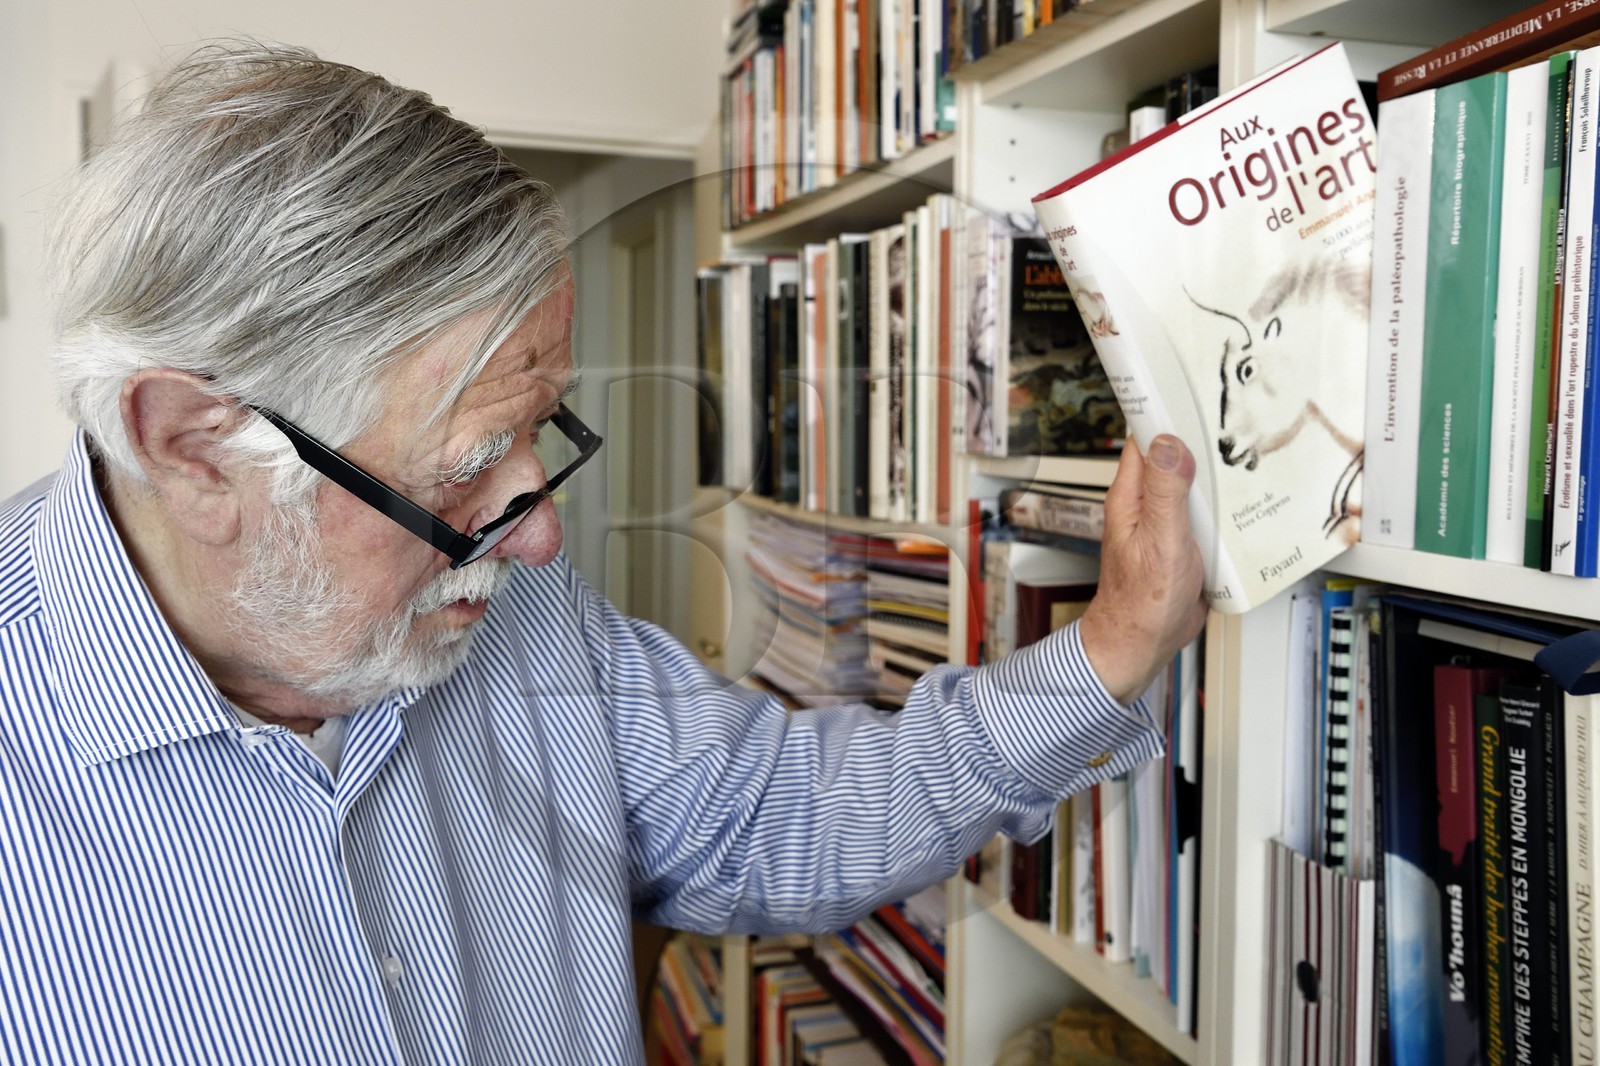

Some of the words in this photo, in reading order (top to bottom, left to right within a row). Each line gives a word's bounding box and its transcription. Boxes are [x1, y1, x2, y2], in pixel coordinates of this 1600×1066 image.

[1429, 58, 1442, 70] LA
[1445, 51, 1457, 66] ET
[1580, 68, 1593, 118] Soleilhavoup
[1220, 114, 1265, 152] Aux
[1454, 100, 1467, 180] biographique
[1579, 120, 1590, 152] François
[1168, 97, 1366, 226] Origines
[1266, 206, 1294, 232] de
[1286, 138, 1377, 215] l'art
[1299, 200, 1353, 240] Emmanuel
[1451, 183, 1462, 246] Répertoire
[1556, 208, 1564, 233] Nebra
[1392, 176, 1408, 304] paléopathologie
[1556, 234, 1563, 244] de
[1555, 246, 1565, 274] Disque
[1572, 235, 1585, 292] préhistorique
[1554, 274, 1562, 284] Le
[1389, 310, 1400, 324] la
[1569, 295, 1581, 326] Sahara
[1389, 329, 1400, 347] de
[1569, 328, 1579, 339] du
[1568, 342, 1580, 377] rupestre
[1385, 352, 1399, 442] L'invention
[1565, 380, 1576, 397] l'art
[1565, 400, 1575, 420] dans
[1442, 404, 1452, 454] sciences
[1544, 423, 1554, 463] Crowhurst
[1563, 422, 1574, 460] sexualité
[1440, 457, 1450, 478] des
[1543, 465, 1552, 494] Howard
[1563, 462, 1572, 470] et
[1232, 500, 1262, 523] Préface
[1264, 490, 1275, 502] de
[1438, 480, 1449, 537] Académie
[1559, 472, 1572, 509] Érotisme
[1236, 518, 1256, 532] Yves
[1256, 494, 1292, 520] Coppens
[1259, 546, 1304, 582] Fayard
[1482, 724, 1502, 797] Grand
[1577, 714, 1591, 806] AUJOURD'HUI
[1509, 747, 1527, 842] MONGOLIE
[1484, 800, 1502, 858] traité
[1576, 810, 1586, 820] À
[1512, 846, 1528, 874] EN
[1577, 822, 1588, 870] D'HIER
[1484, 862, 1504, 894] des
[1485, 896, 1505, 964] herbes
[1513, 876, 1530, 960] STEPPES
[1576, 882, 1594, 1038] CHAMPAGNE
[1514, 964, 1531, 1000] DES
